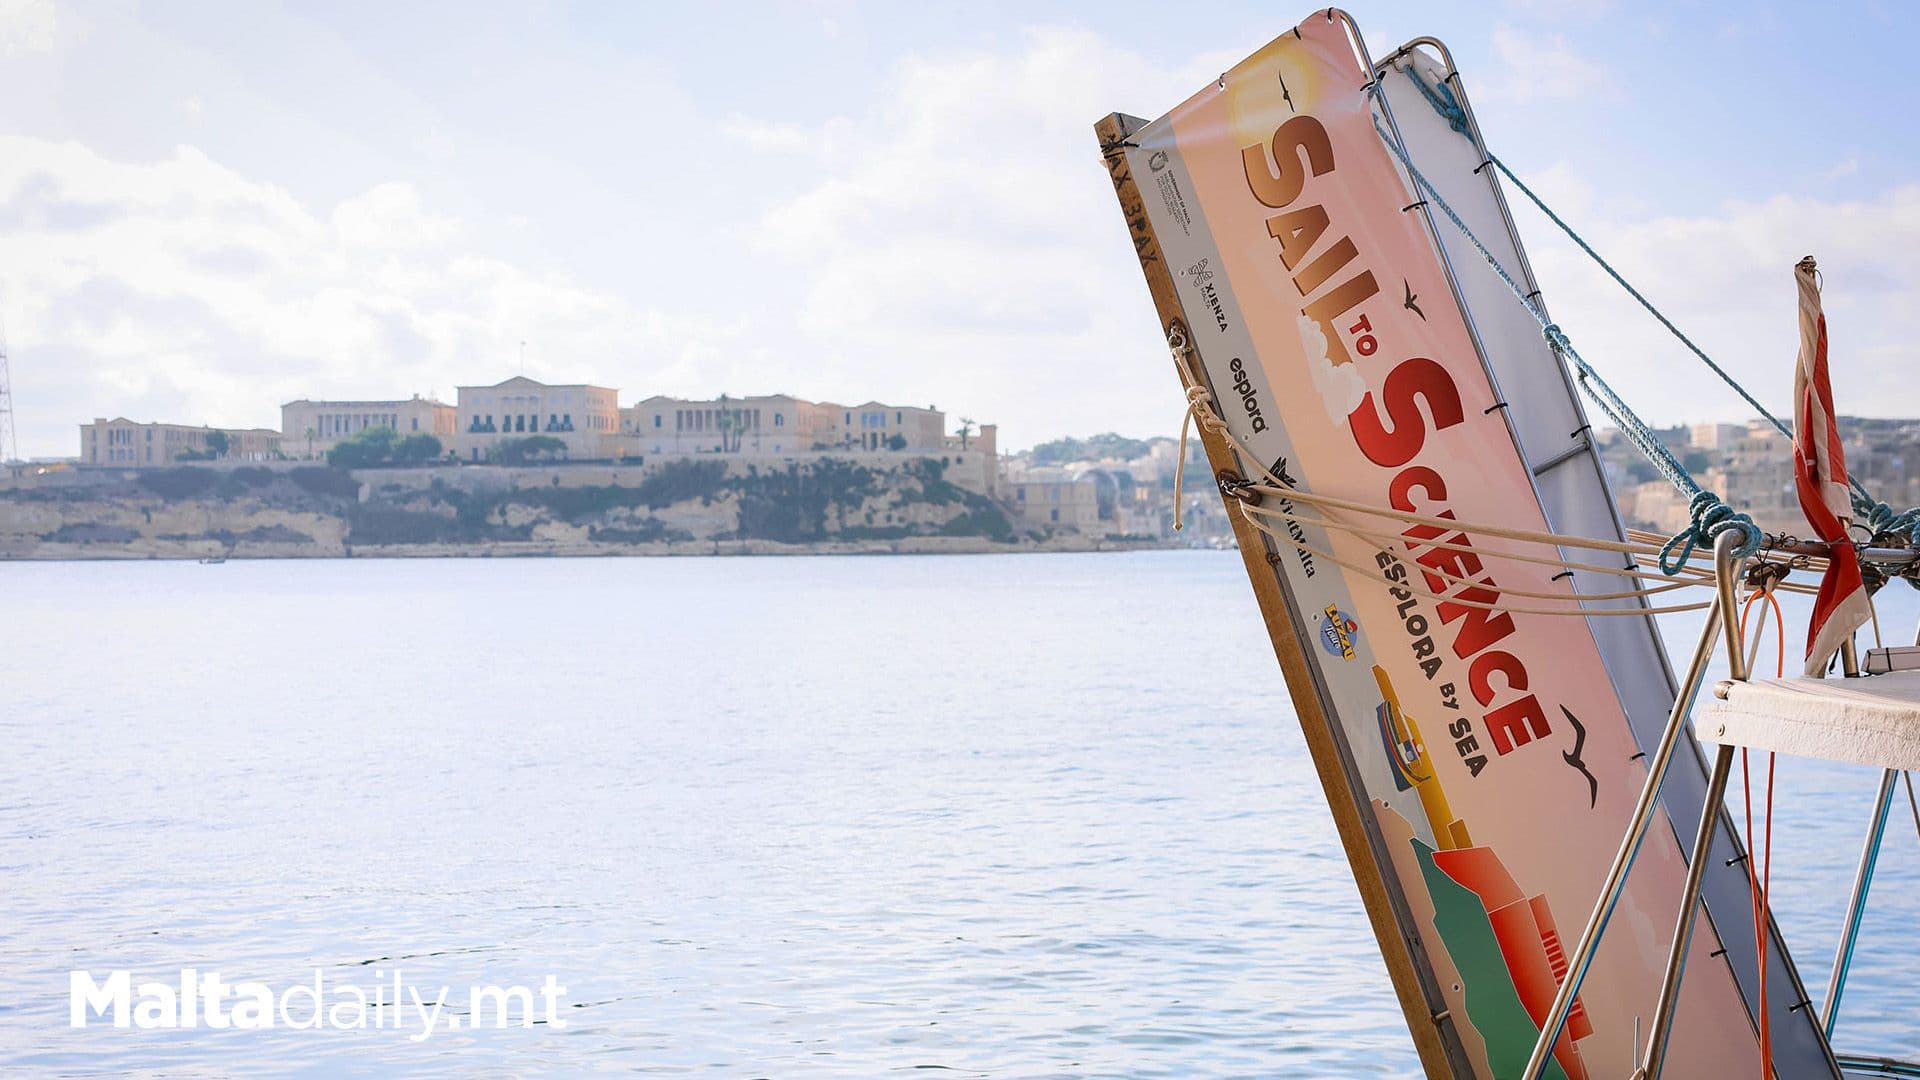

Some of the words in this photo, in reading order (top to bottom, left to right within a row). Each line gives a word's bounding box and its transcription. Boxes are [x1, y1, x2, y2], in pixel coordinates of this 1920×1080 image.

[1241, 115, 1380, 367] SAIL
[1205, 283, 1228, 333] XJENZA
[1350, 314, 1378, 356] TO
[1230, 357, 1266, 434] esplora
[1348, 357, 1552, 756] SCIENCE
[1324, 603, 1356, 661] LUZZU
[1375, 547, 1443, 681] ESPLORA
[1448, 717, 1489, 778] SEA
